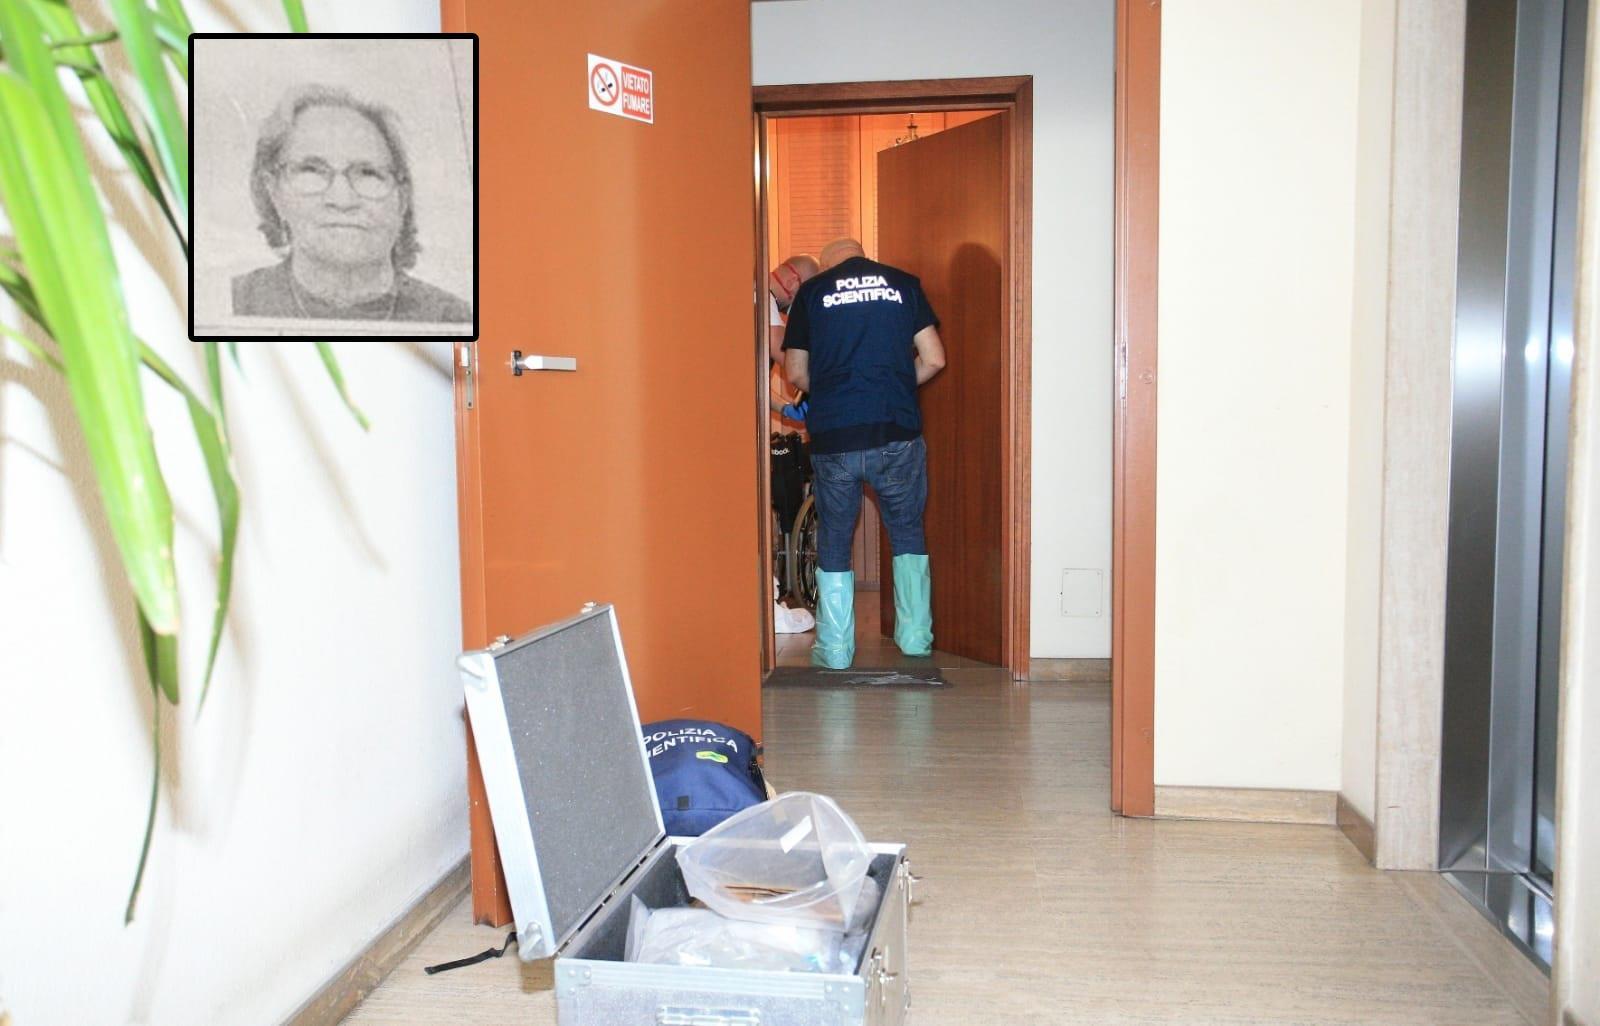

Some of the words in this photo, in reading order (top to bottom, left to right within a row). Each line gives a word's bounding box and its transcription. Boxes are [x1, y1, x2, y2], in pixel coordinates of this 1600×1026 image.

[623, 72, 649, 94] VIETATO
[623, 93, 650, 114] FUMARE
[836, 275, 888, 291] POLIZIA
[823, 288, 903, 308] SCIENTIFICA
[648, 736, 738, 758] IENTIFICA
